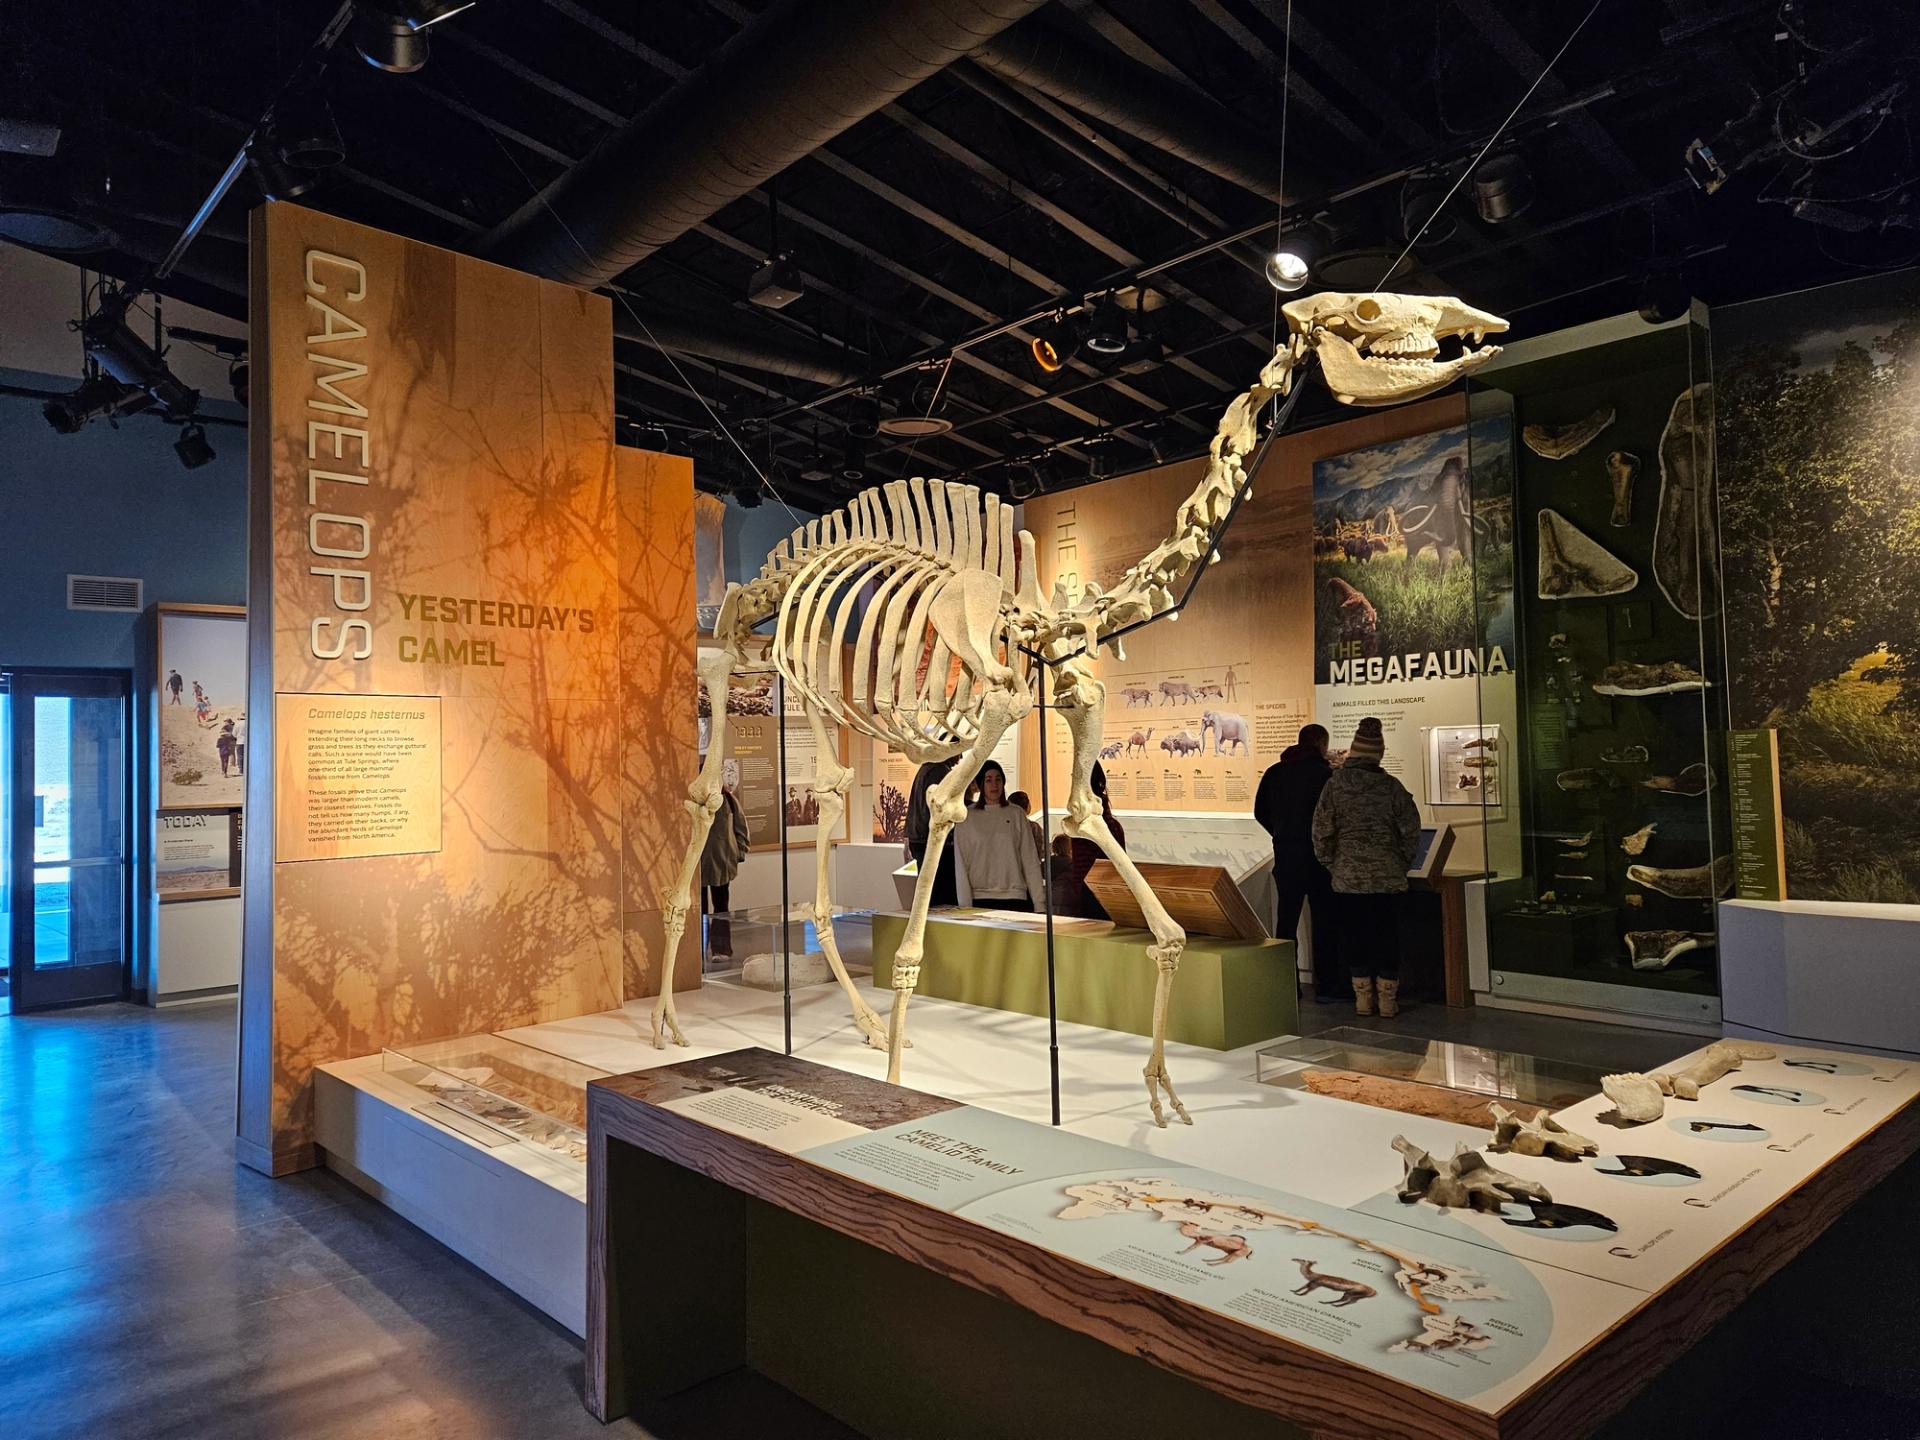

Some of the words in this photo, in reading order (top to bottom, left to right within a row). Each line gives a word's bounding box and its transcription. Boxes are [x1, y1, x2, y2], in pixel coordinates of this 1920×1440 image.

[305, 249, 373, 662] CAMELOPS
[397, 593, 595, 633] YESTERDAY'S
[398, 635, 505, 667] CAMEL
[1327, 640, 1362, 659] THE
[1329, 645, 1510, 684] MEGAFAUNA
[308, 708, 367, 721] Camelops
[370, 709, 426, 720] hesternus
[164, 814, 211, 829] TODAY
[894, 1133, 964, 1157] CAMELID
[960, 1154, 1024, 1175] FAMILY
[909, 1129, 956, 1144] MEET
[952, 1141, 988, 1155] THE
